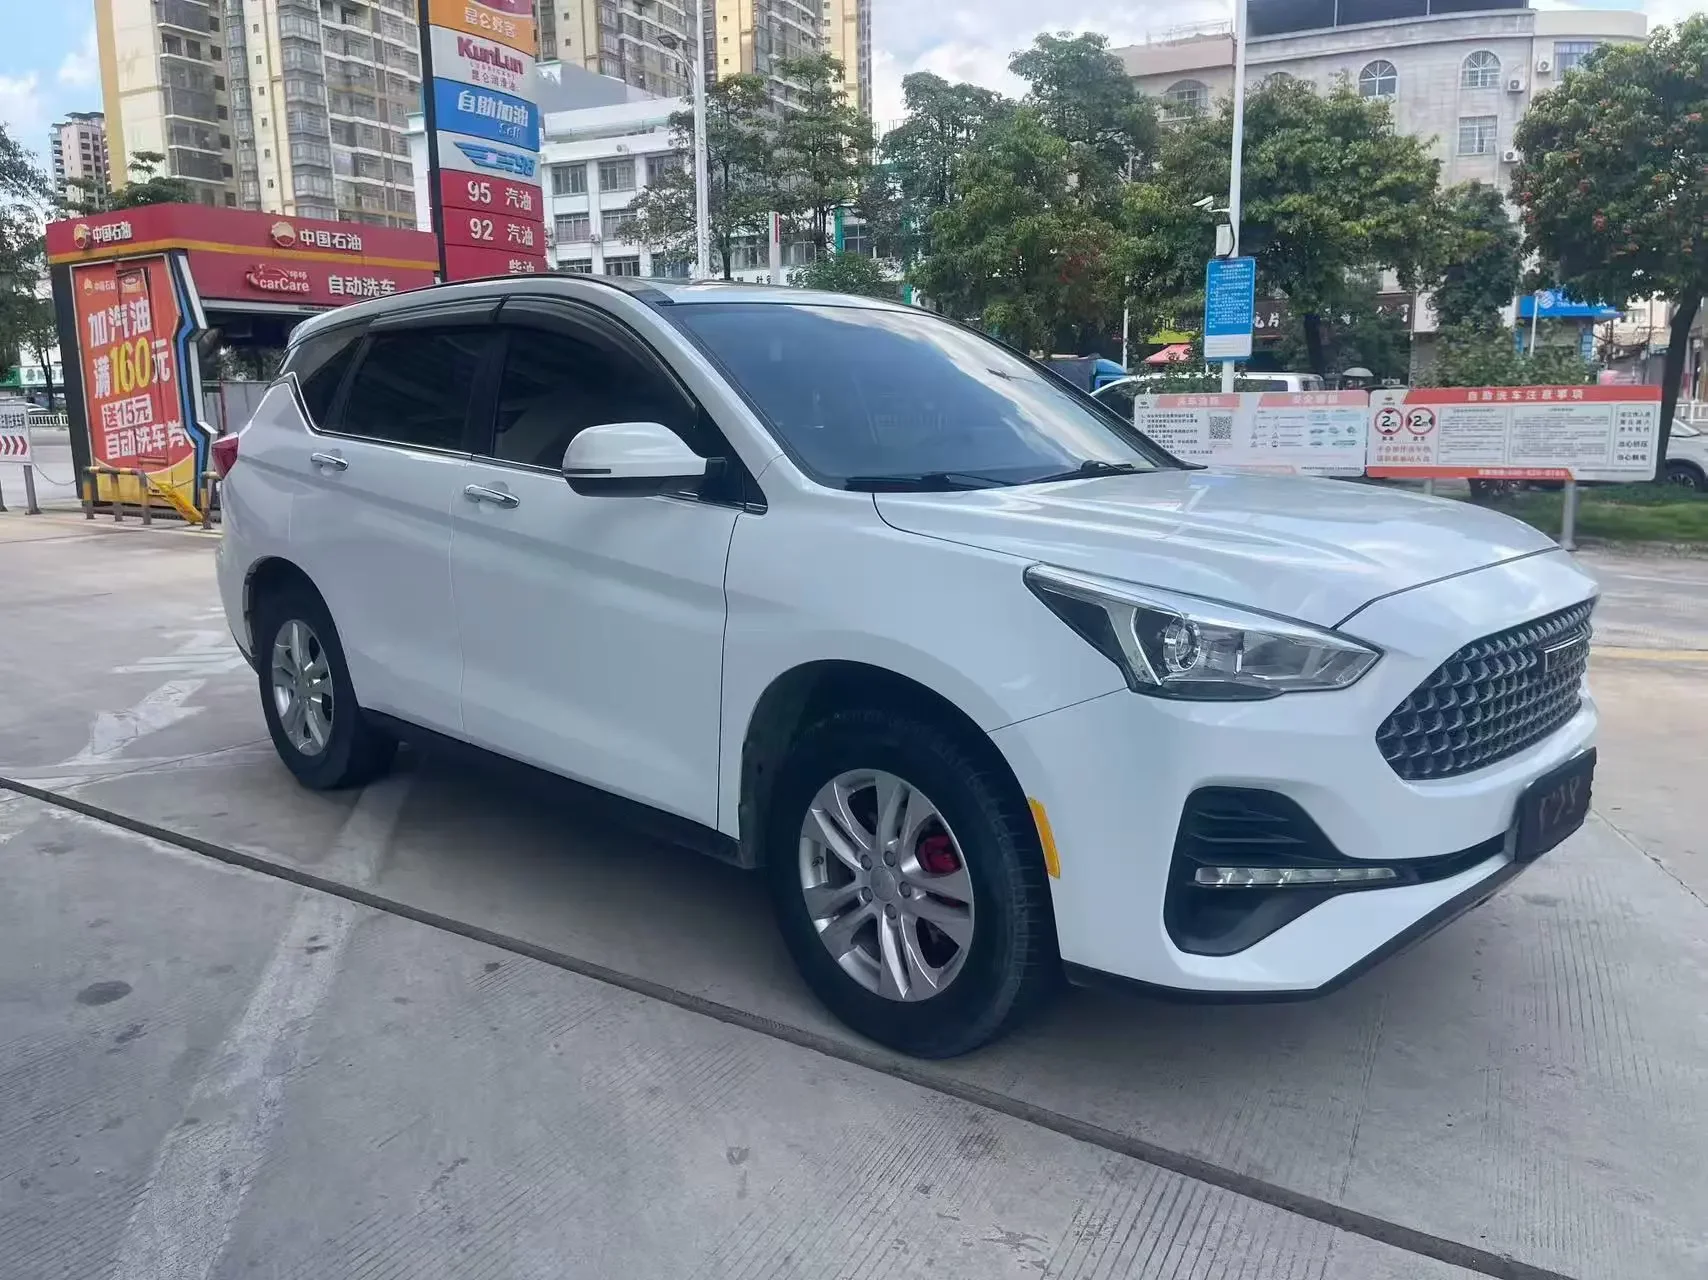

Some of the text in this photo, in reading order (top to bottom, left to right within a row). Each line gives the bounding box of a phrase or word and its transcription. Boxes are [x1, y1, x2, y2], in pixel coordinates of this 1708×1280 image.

[457, 36, 524, 75] KunLun
[458, 90, 529, 127] 自助加油
[468, 181, 532, 211] 95 汽油
[92, 221, 132, 243] 中国石油
[299, 228, 362, 251] 中国石油
[470, 218, 534, 246] 92 汽油
[259, 277, 310, 292] carCare
[328, 274, 396, 296] 自动洗车
[88, 297, 151, 348] 加汽油
[106, 420, 185, 460] 自动洗车券
